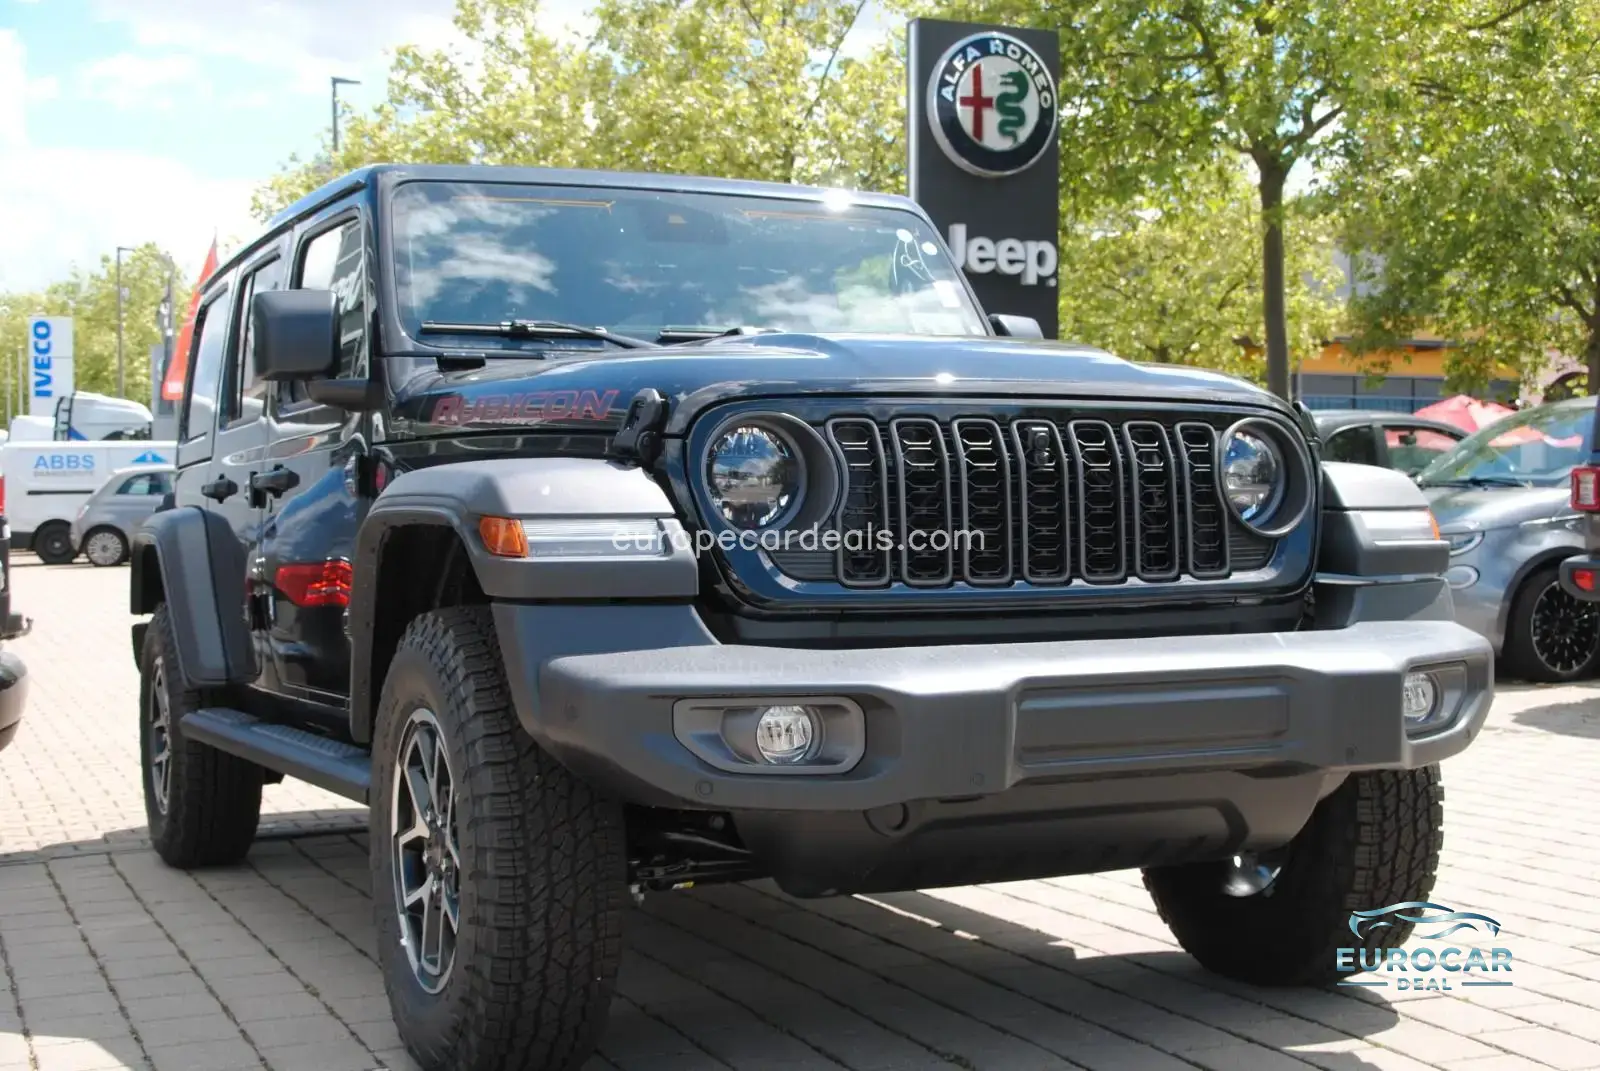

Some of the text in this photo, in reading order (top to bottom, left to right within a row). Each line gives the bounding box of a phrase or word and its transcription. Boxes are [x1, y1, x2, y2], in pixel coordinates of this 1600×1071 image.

[940, 38, 1052, 109] ALFA ROMEO
[34, 321, 52, 396] IVECO
[431, 389, 620, 426] RUBICON
[33, 455, 96, 470] ABBS
